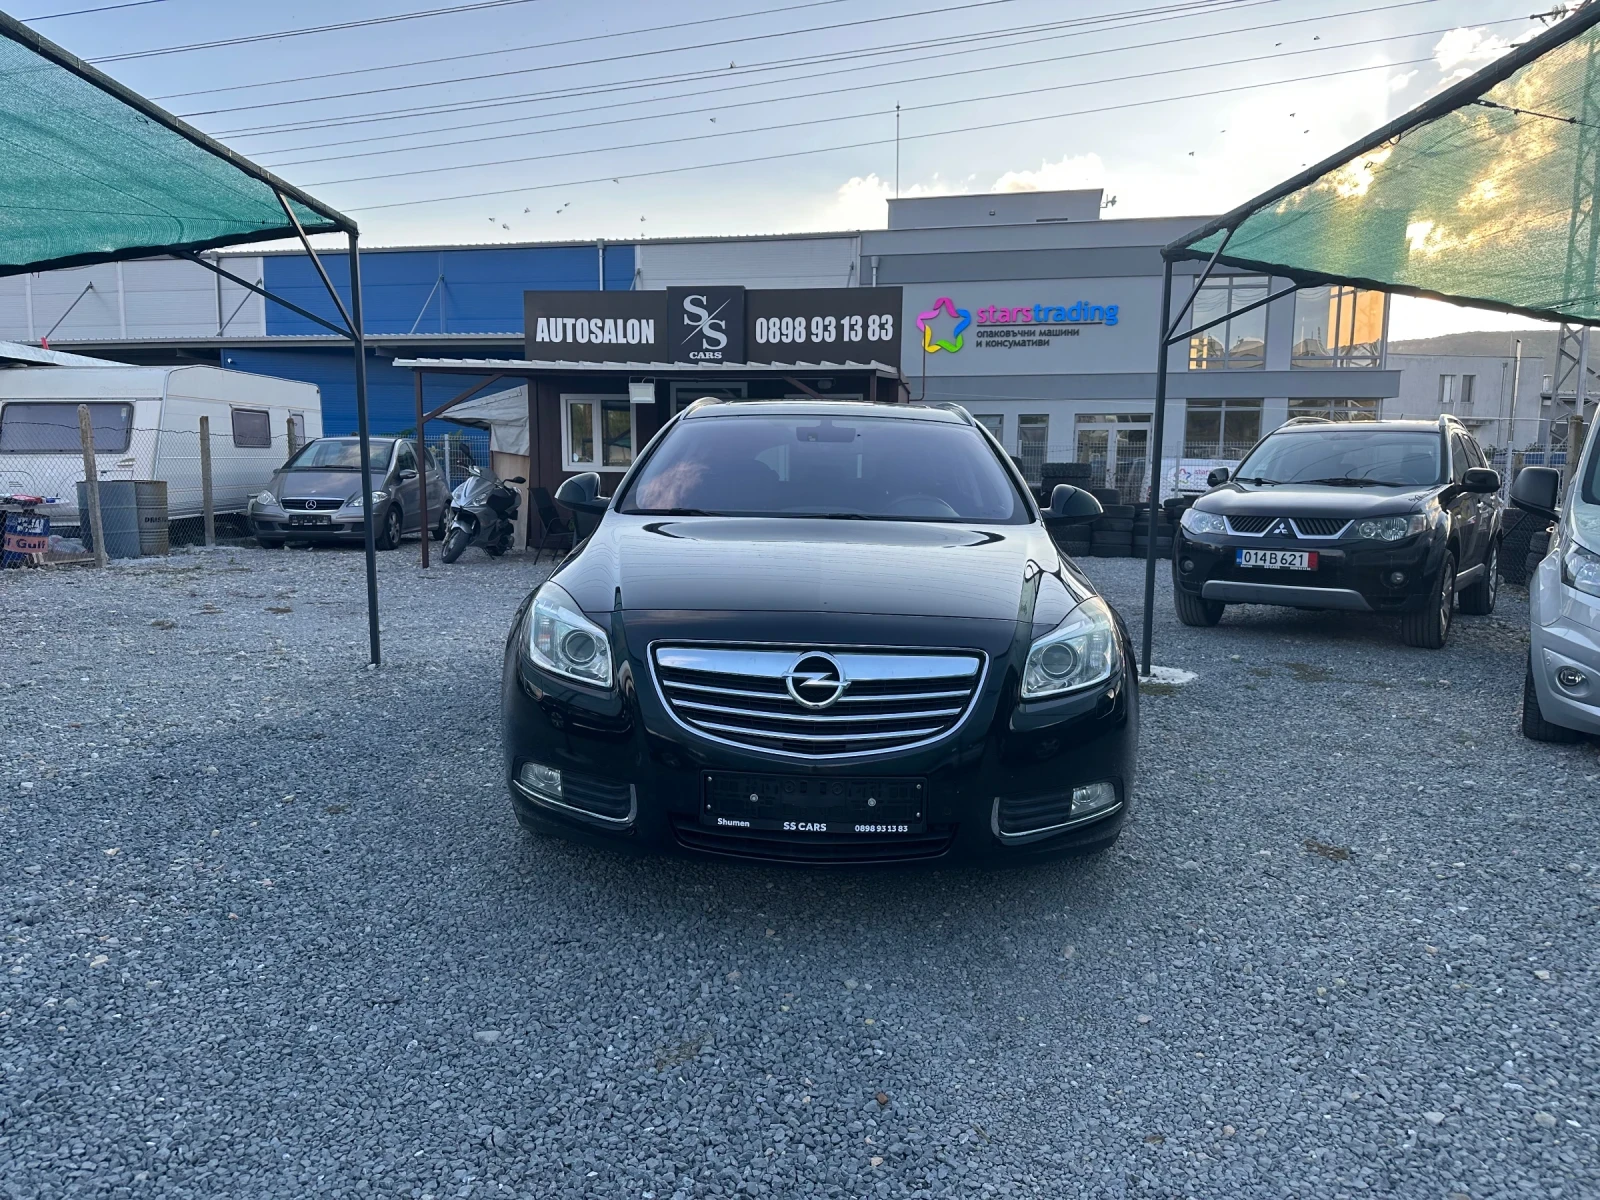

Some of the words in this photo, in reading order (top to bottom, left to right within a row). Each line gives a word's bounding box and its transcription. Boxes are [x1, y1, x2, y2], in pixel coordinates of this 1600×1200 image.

[977, 301, 1119, 326] starstrading
[535, 317, 655, 344] AUTOSALON
[755, 317, 806, 344] 0898
[810, 316, 836, 343] 93
[840, 315, 863, 342] 13
[867, 314, 894, 341] 83
[976, 329, 1036, 338] опаковъчни
[1039, 328, 1080, 337] машини
[976, 340, 982, 348] и
[985, 339, 1050, 349] консумативи
[689, 351, 723, 360] CARS
[16, 538, 45, 549] Gulf
[717, 817, 750, 828] Shumen
[783, 821, 797, 831] SS
[798, 822, 827, 832] CARS
[854, 824, 876, 833] 0898
[876, 825, 887, 833] 93
[887, 825, 897, 833] 13
[897, 825, 908, 833] 83
